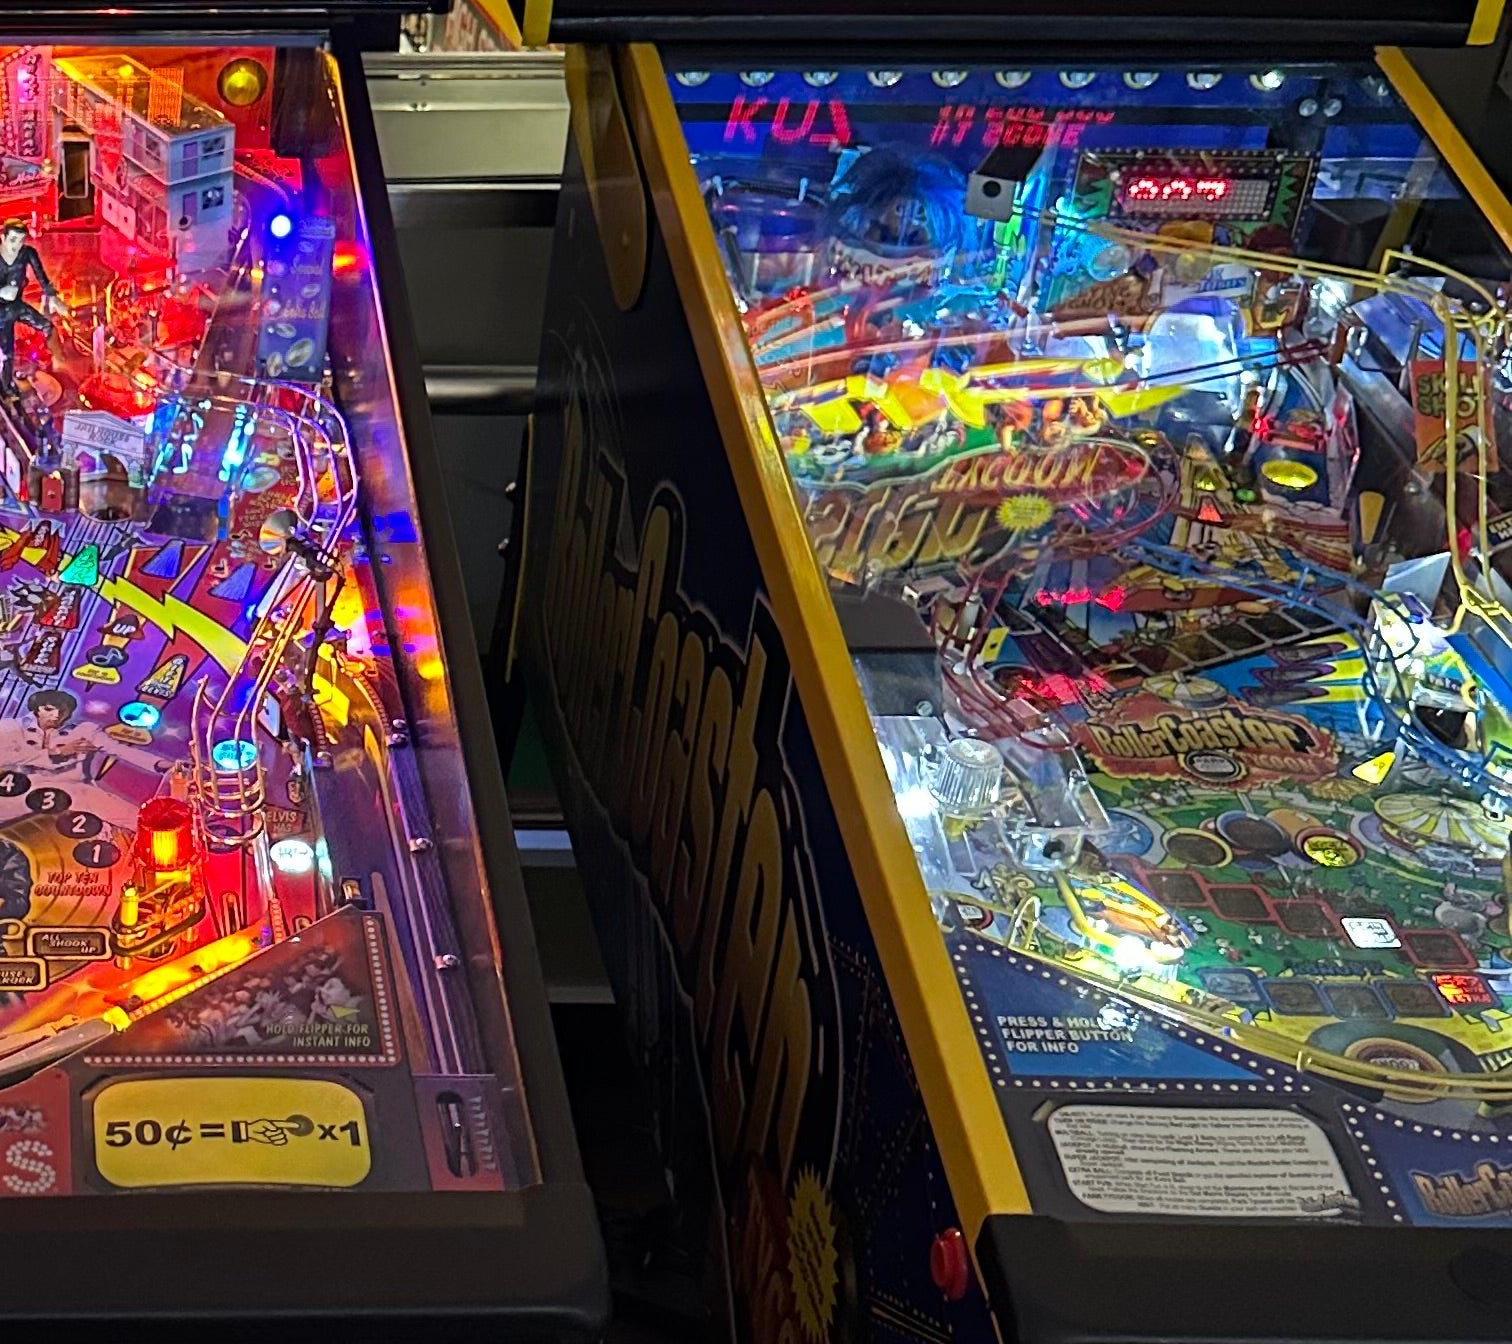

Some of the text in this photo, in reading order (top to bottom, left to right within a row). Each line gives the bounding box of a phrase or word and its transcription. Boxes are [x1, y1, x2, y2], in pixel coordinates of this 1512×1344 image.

[113, 624, 136, 634] UP
[1089, 709, 1301, 758] RollerCoaster
[0, 774, 15, 792] 4
[41, 791, 55, 809] 3
[71, 815, 87, 834] 2
[92, 845, 101, 863] 1
[267, 811, 297, 822] ELVIS
[47, 871, 76, 883] TOP
[34, 883, 112, 897] COUNTDOWN
[80, 946, 97, 954] UP
[997, 1015, 1048, 1028] PRESS
[1052, 1017, 1064, 1027] &
[266, 1023, 369, 1034] HOLD FLIPPER FOR
[1002, 1028, 1134, 1042] FLIPPER BUTTON
[292, 1036, 372, 1047] INSTANT INFO
[1006, 1041, 1080, 1053] FOR INFO
